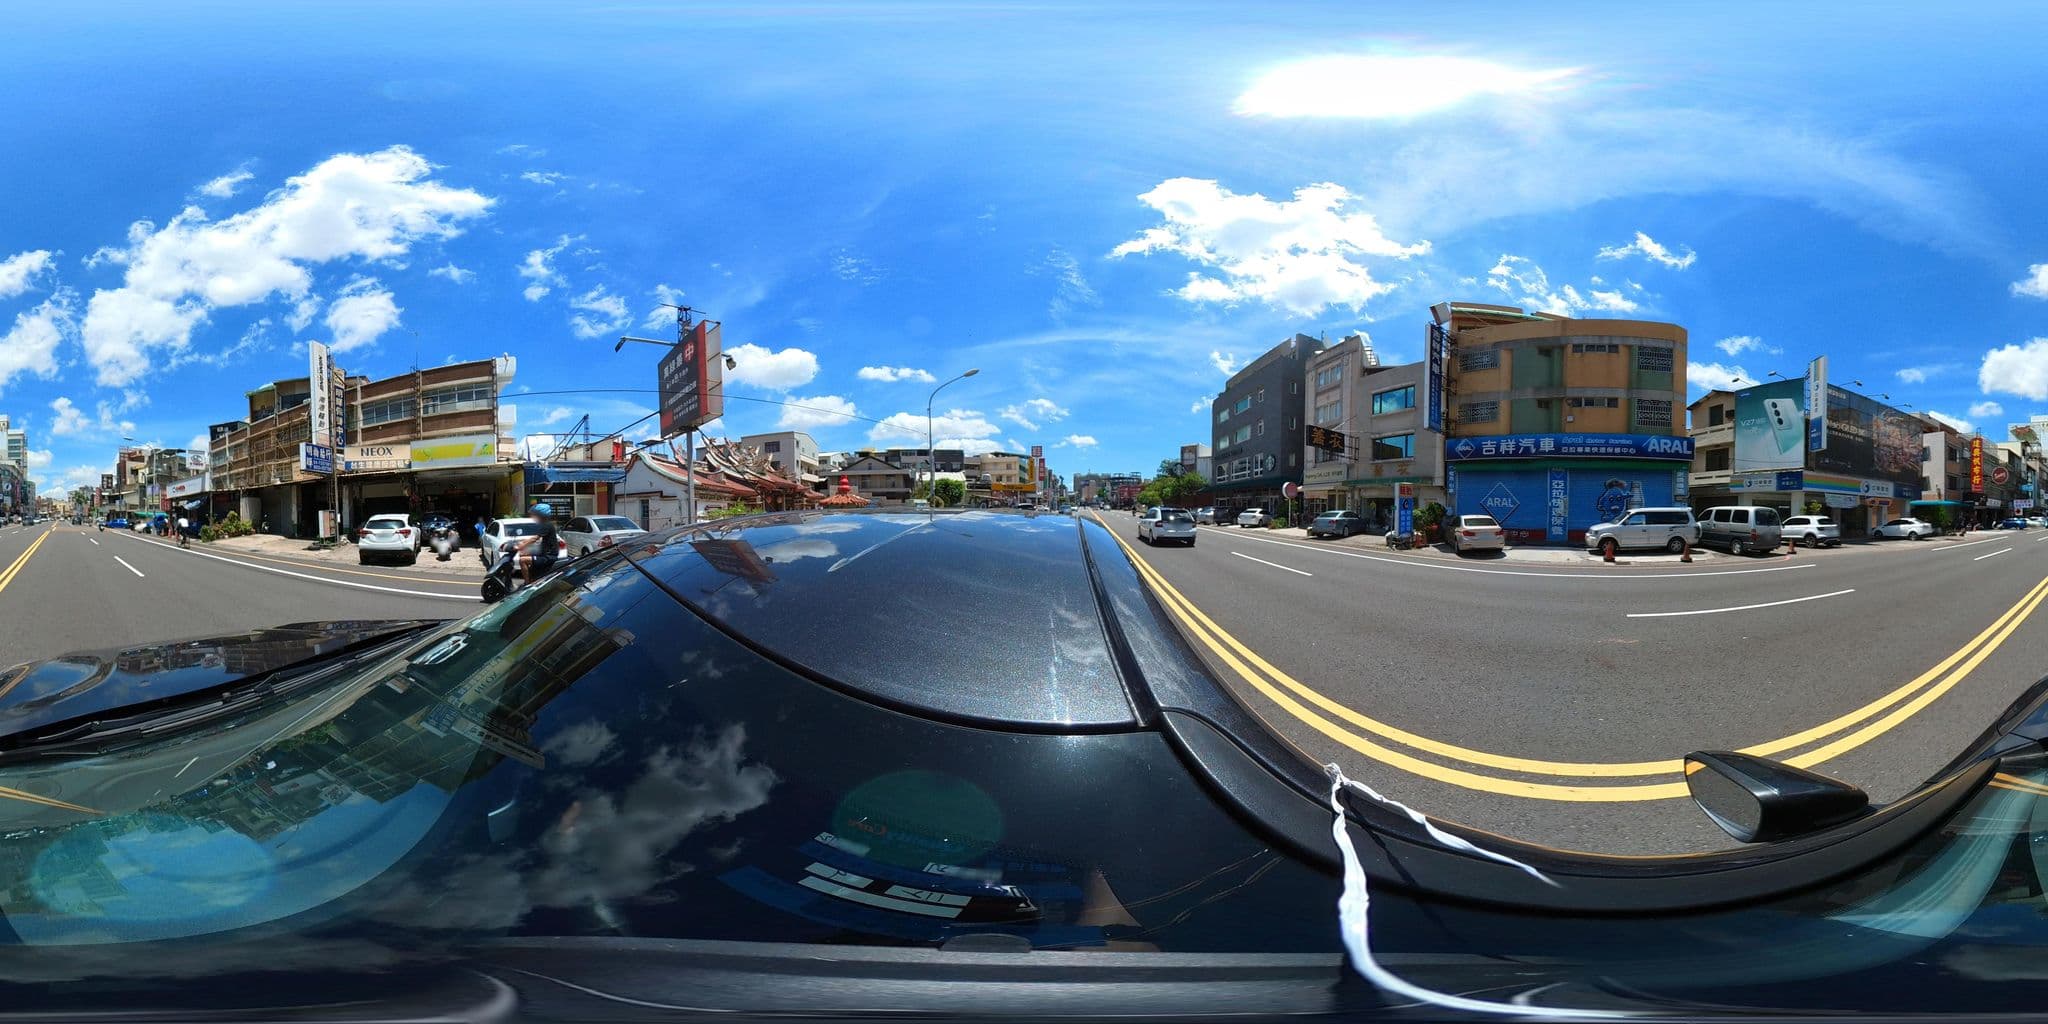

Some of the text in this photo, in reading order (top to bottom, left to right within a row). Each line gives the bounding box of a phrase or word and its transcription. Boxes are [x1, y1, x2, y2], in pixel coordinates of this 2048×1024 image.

[361, 447, 393, 457] NEOX
[1481, 437, 1556, 455] 吉祥汽車
[1647, 437, 1693, 455] ARAL
[1486, 497, 1513, 508] ARAL
